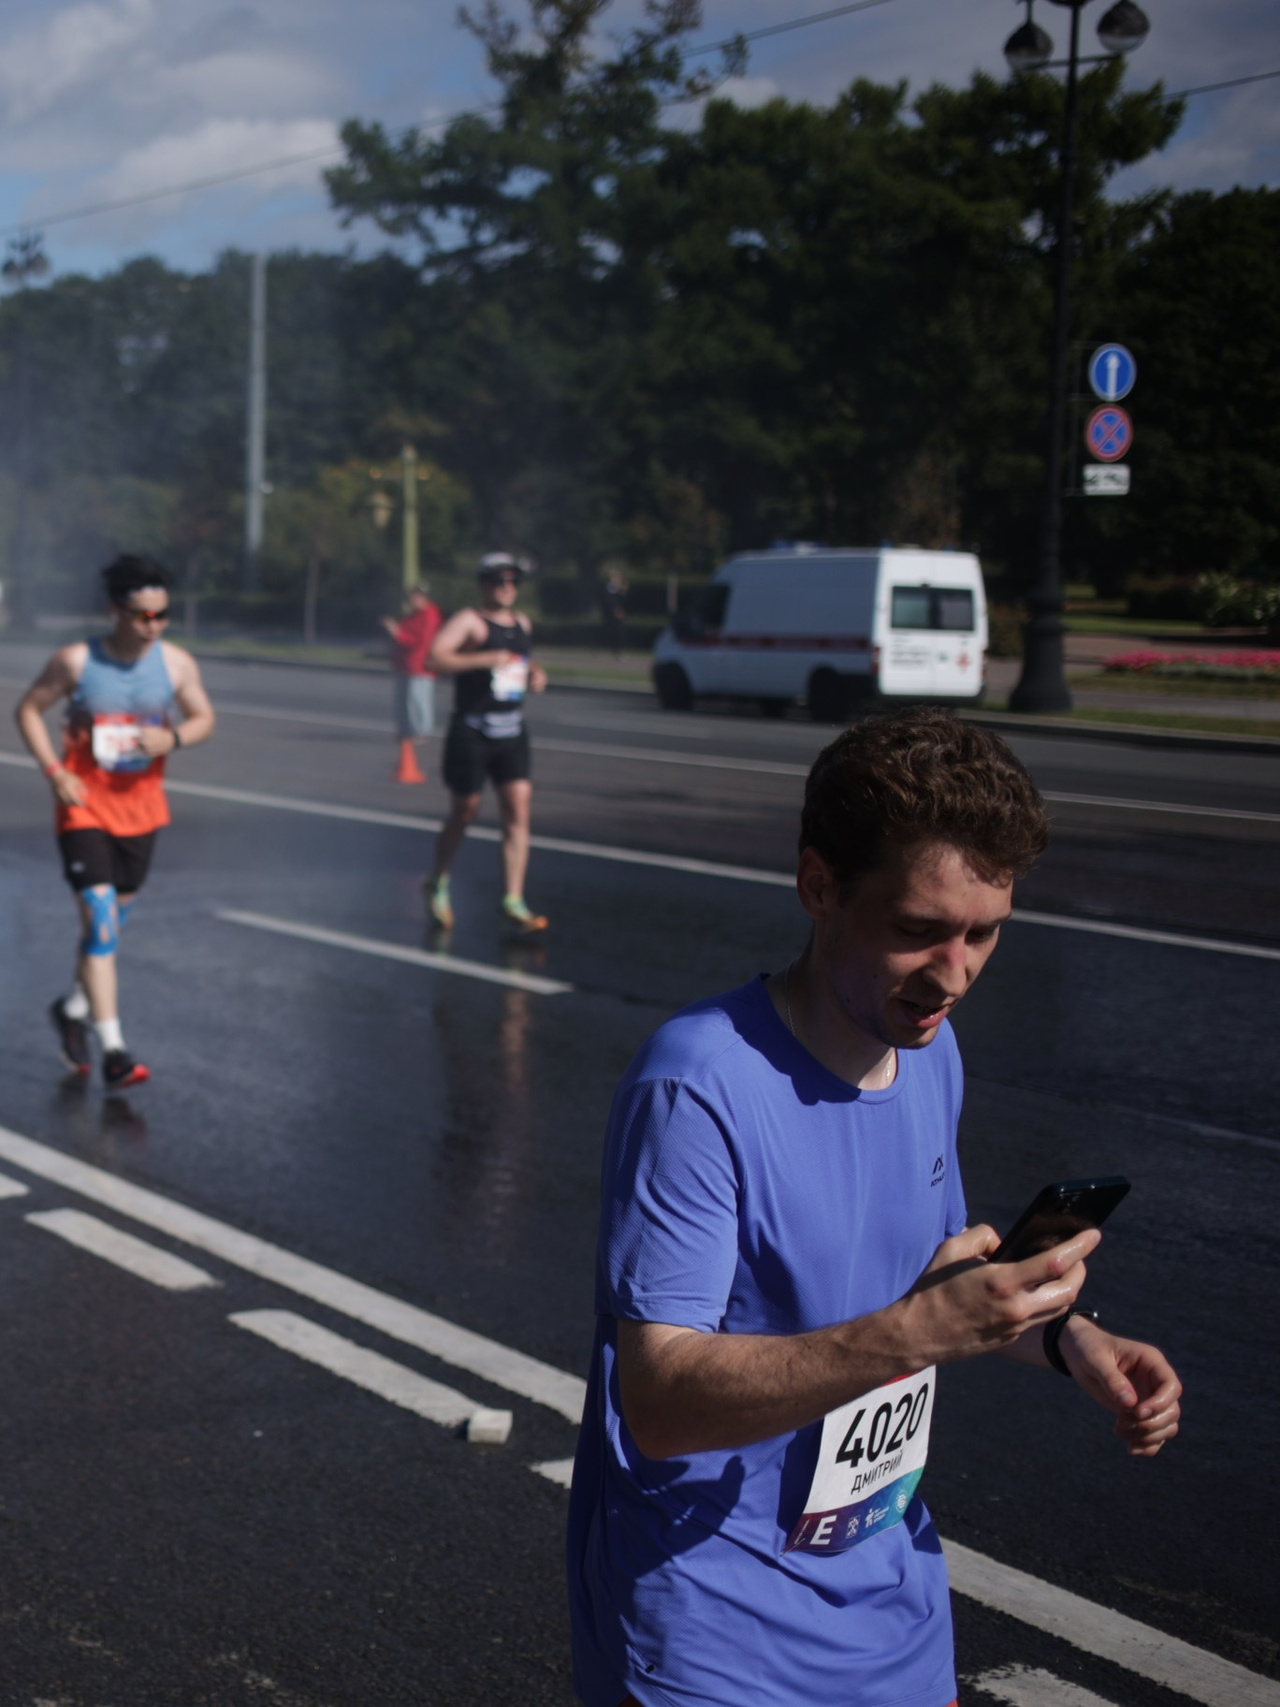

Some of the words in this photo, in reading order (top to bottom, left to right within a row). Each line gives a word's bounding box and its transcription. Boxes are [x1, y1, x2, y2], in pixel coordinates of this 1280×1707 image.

[834, 1382, 929, 1468] 4020
[850, 1449, 904, 1495] ДМИТРИЙ
[809, 1515, 838, 1545] E
